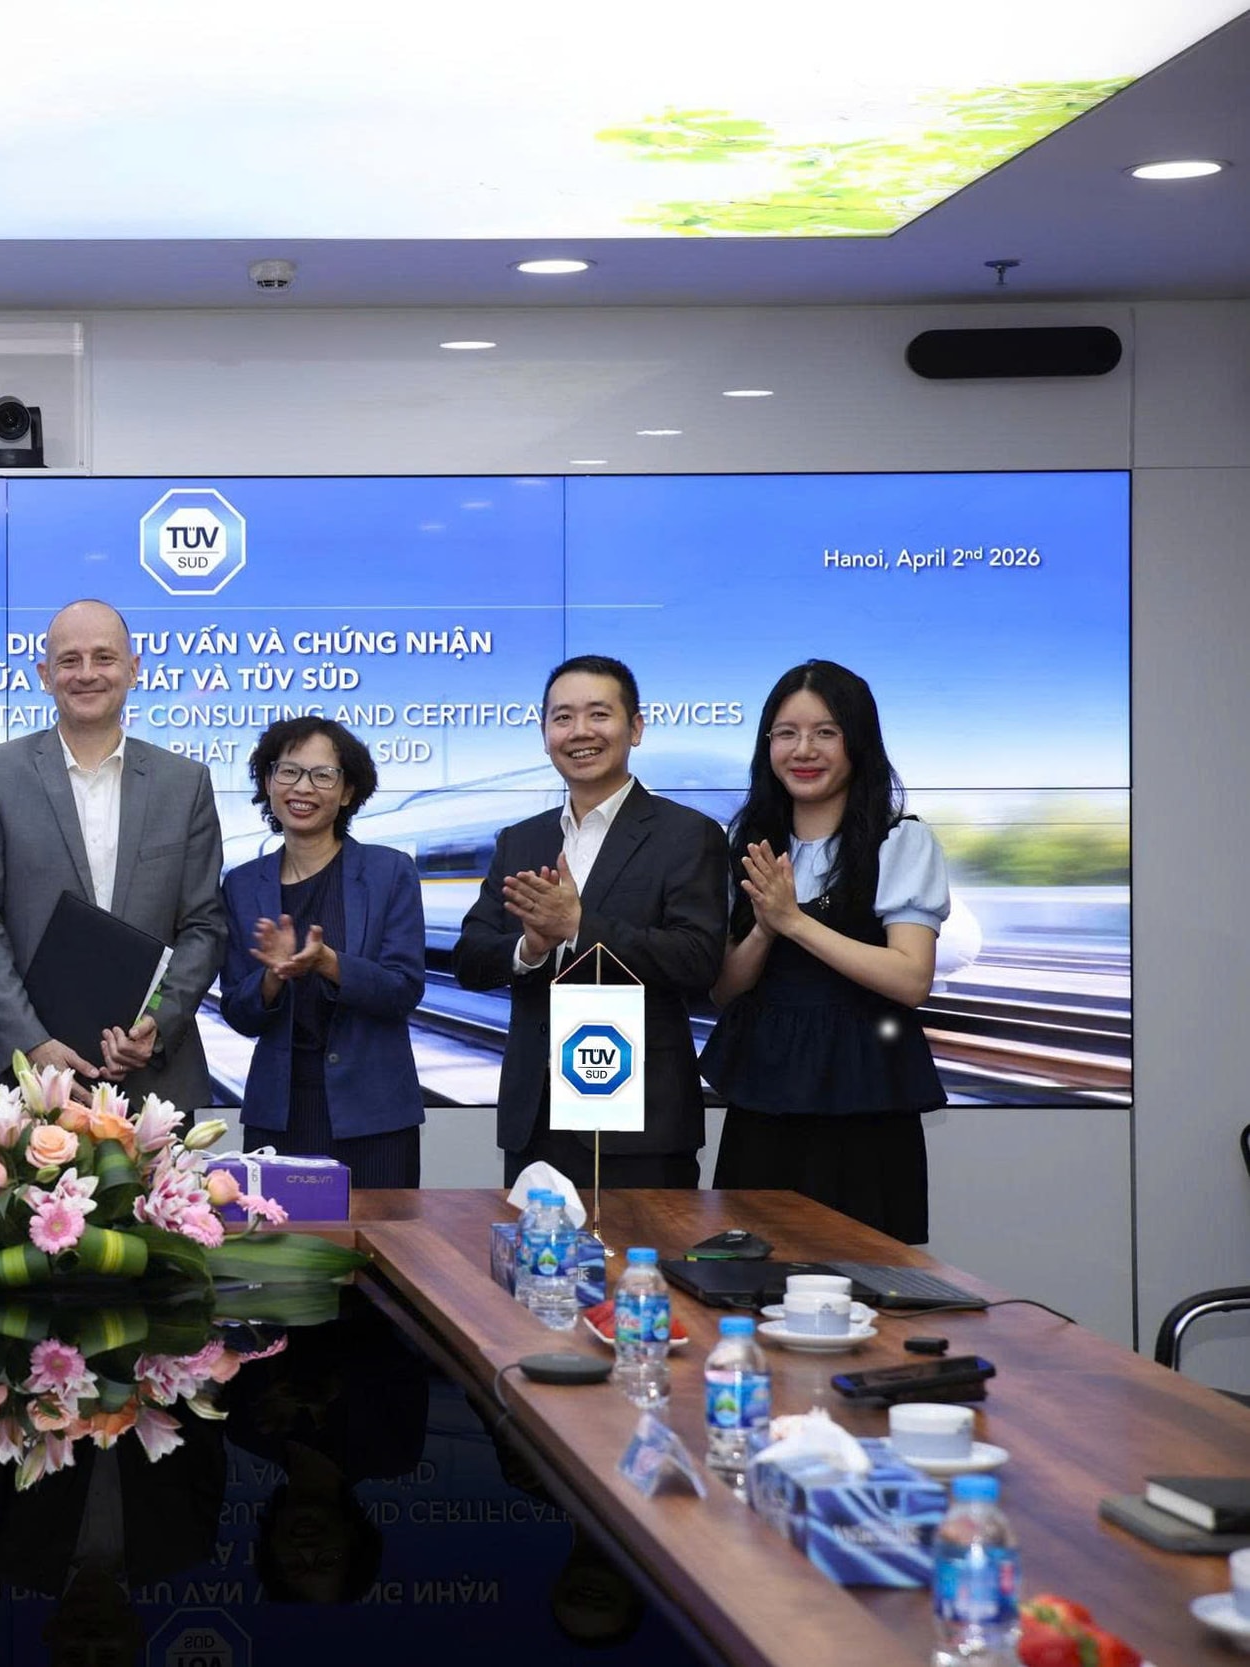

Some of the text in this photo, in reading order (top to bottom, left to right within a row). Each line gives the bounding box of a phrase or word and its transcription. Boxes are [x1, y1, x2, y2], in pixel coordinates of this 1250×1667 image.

[166, 526, 219, 549] TÜV
[824, 548, 889, 570] Hanoi,
[896, 547, 945, 573] April
[989, 547, 1041, 567] 2026
[133, 631, 169, 655] TƯ
[177, 624, 238, 654] VẤN
[246, 627, 285, 654] VÀ
[293, 625, 396, 654] CHỨNG
[406, 626, 492, 660] NHẬN
[131, 663, 184, 691] HÁT
[191, 663, 230, 691] VÀ
[238, 664, 295, 690] TÜV
[302, 663, 359, 690] SÜD
[333, 705, 394, 727] AND
[638, 702, 743, 725] ERVICES
[374, 735, 431, 763] SÜD
[578, 1048, 616, 1065] TÜV
